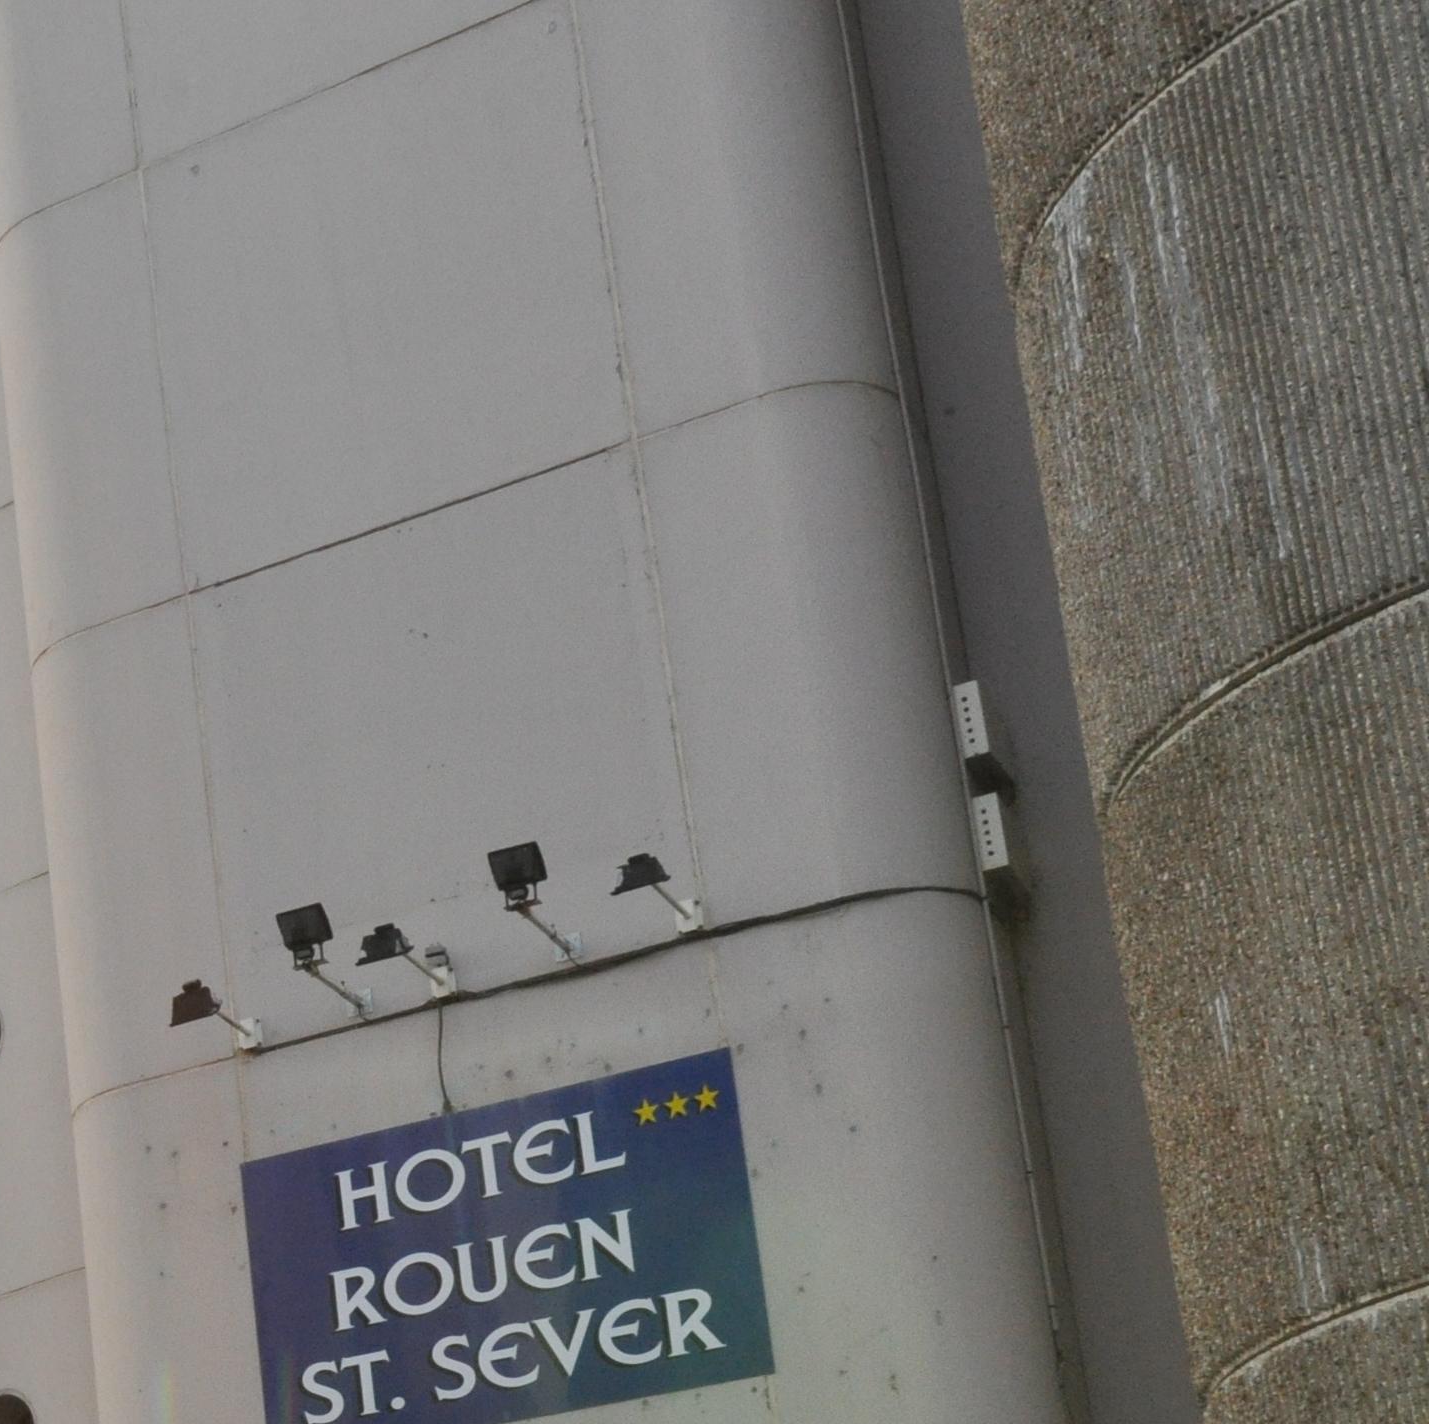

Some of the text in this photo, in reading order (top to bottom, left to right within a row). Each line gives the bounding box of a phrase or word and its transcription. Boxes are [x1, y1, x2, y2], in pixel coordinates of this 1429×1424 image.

[334, 1110, 627, 1232] HOTEL
[329, 1208, 637, 1333] ROUEN
[430, 1287, 727, 1402] SEVER
